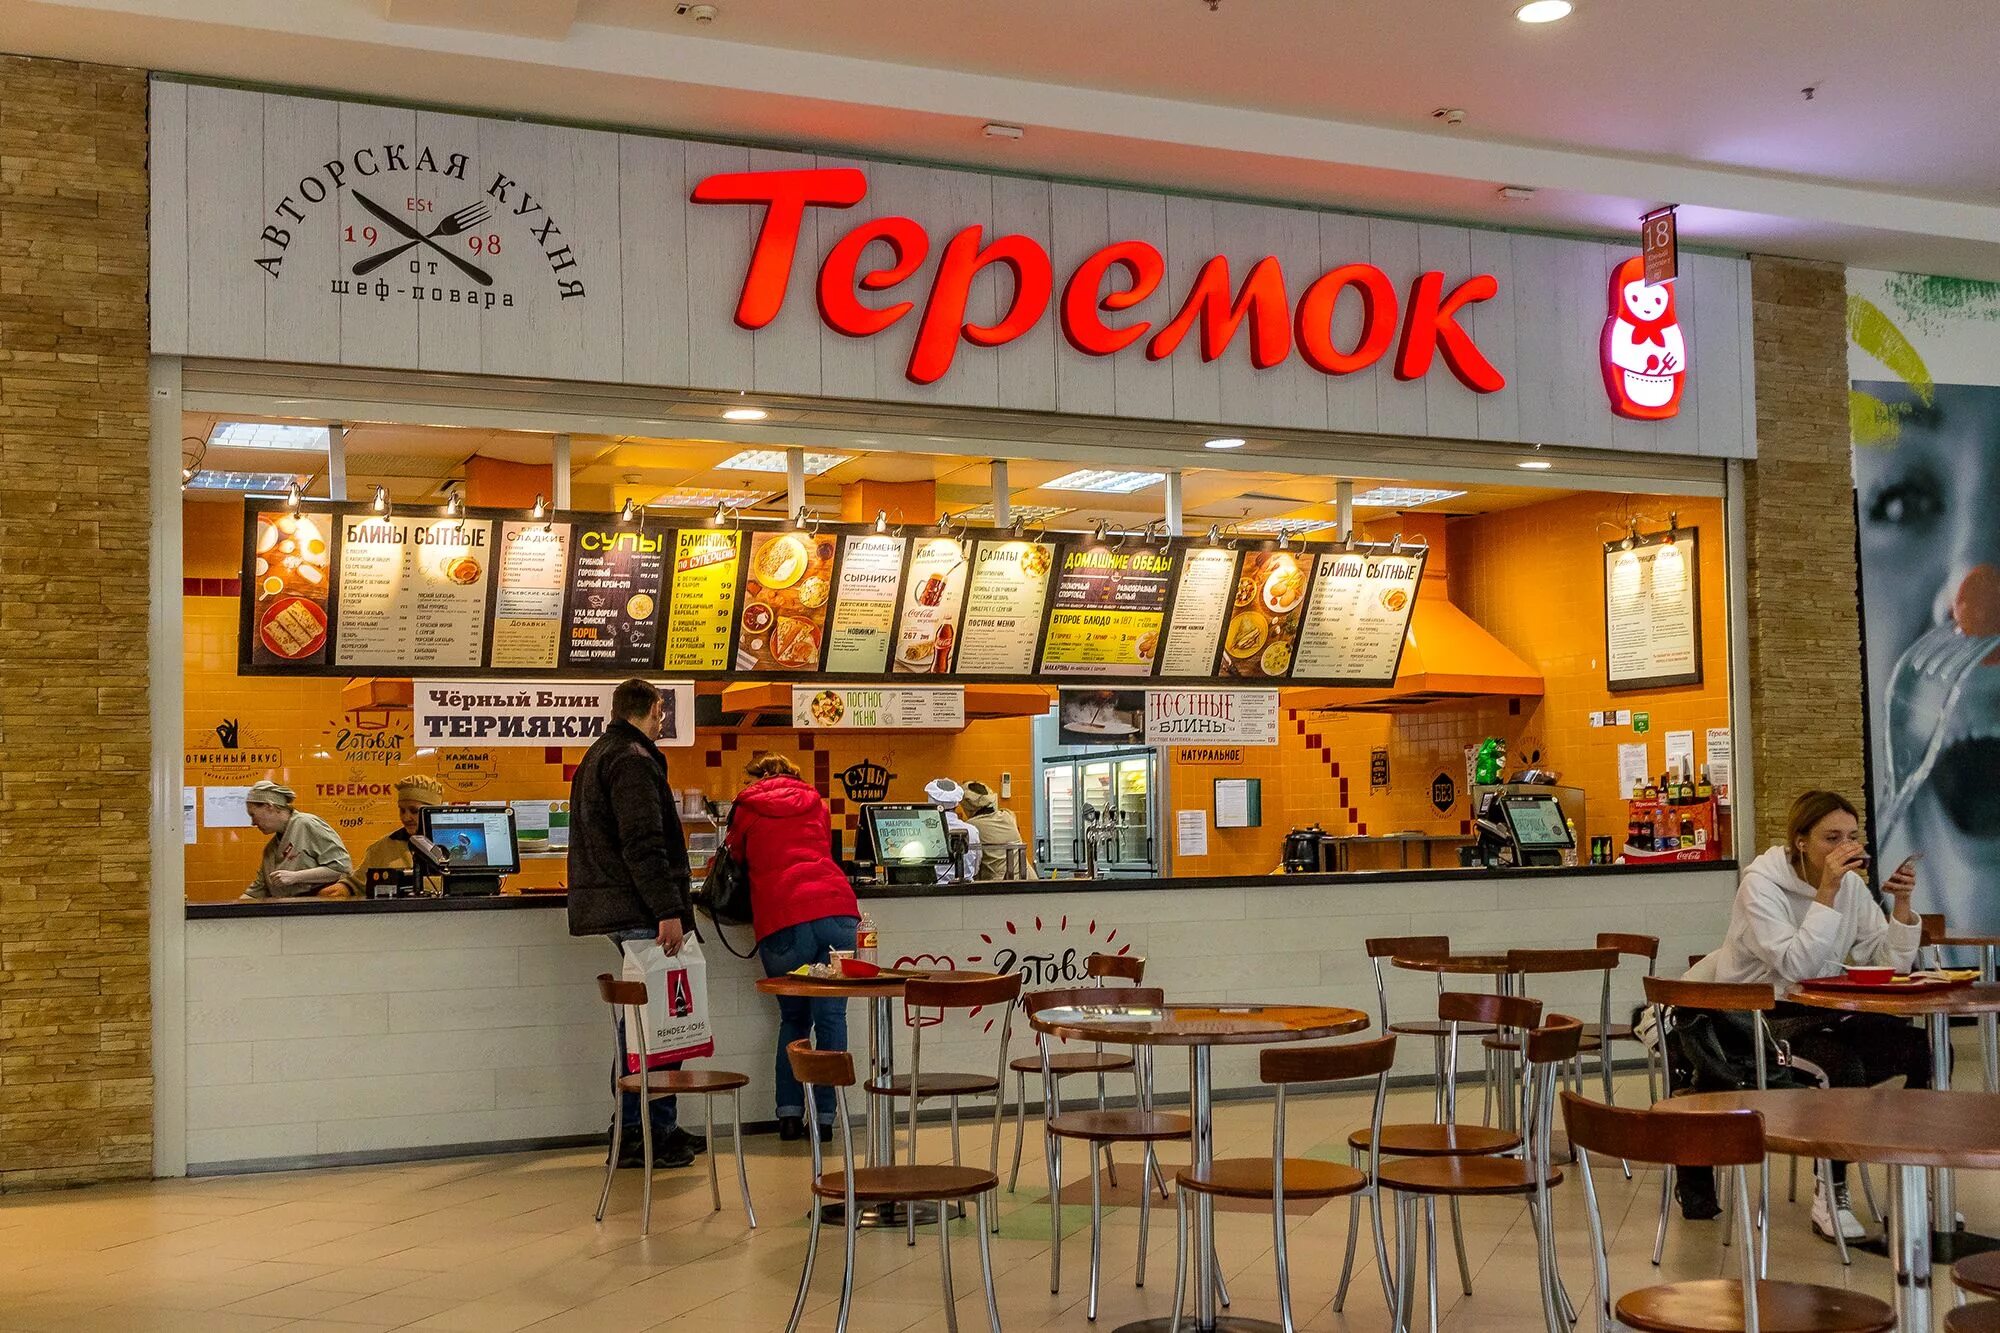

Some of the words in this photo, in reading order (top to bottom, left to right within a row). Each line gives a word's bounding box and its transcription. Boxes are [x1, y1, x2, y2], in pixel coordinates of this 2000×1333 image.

[253, 143, 469, 279] АВТОРСКАЯ
[486, 171, 586, 301] КУХНЯ
[344, 225, 378, 248] 19
[1646, 220, 1669, 252] 18
[468, 233, 502, 257] 98
[410, 260, 438, 275] от
[690, 167, 1505, 394] Теремок
[330, 278, 514, 309] шеф-повара
[347, 524, 407, 545] БЛИНЫ
[414, 526, 485, 547] СЫТНЫЕ
[580, 531, 663, 553] СУПЫ
[980, 548, 1018, 562] САЛАТЫ
[1064, 552, 1130, 570] ДОМАШНИЕ
[678, 559, 688, 569] ПО
[1320, 561, 1364, 578] БЛИНЫ
[1366, 563, 1417, 580] СЫТНЫЕ
[720, 582, 732, 590] 99
[844, 574, 897, 584] СЫРНИКИ
[574, 609, 586, 617] УХА
[586, 609, 594, 617] ИЗ
[1053, 614, 1081, 624] ВТОРОЕ
[1083, 616, 1111, 627] БЛЮДО
[716, 626, 727, 634] 99
[968, 619, 996, 628] ПОСТНОЕ
[996, 620, 1016, 628] МЕНЮ
[572, 628, 598, 640] БОРЩ
[1086, 632, 1092, 641] 2
[1121, 634, 1126, 642] 3
[713, 642, 725, 650] 117
[428, 690, 531, 712] Чёрный
[535, 690, 600, 708] Блин
[846, 692, 883, 708] ПОСТНОЕ
[1150, 692, 1235, 723] ПОСТНЫЕ
[853, 710, 876, 726] МЕНЮ
[1159, 718, 1226, 733] БЛИНЫ
[423, 715, 606, 738] ТЕРИЯКИ
[335, 728, 405, 752] Готовят
[186, 752, 247, 764] ОТМЕННЫЙ
[250, 754, 278, 764] ВКУС
[344, 750, 401, 766] мастера
[446, 753, 489, 762] КАЖДЫЙ
[1180, 748, 1241, 762] НАТУРАЛЬНОЕ
[454, 762, 480, 770] ДЕНЬ
[844, 766, 887, 787] СУПЫ
[316, 784, 392, 796] ТЕРЕМОК
[1434, 783, 1452, 802] БЕЗ
[339, 816, 364, 828] 1998
[993, 947, 1100, 986] Готовя
